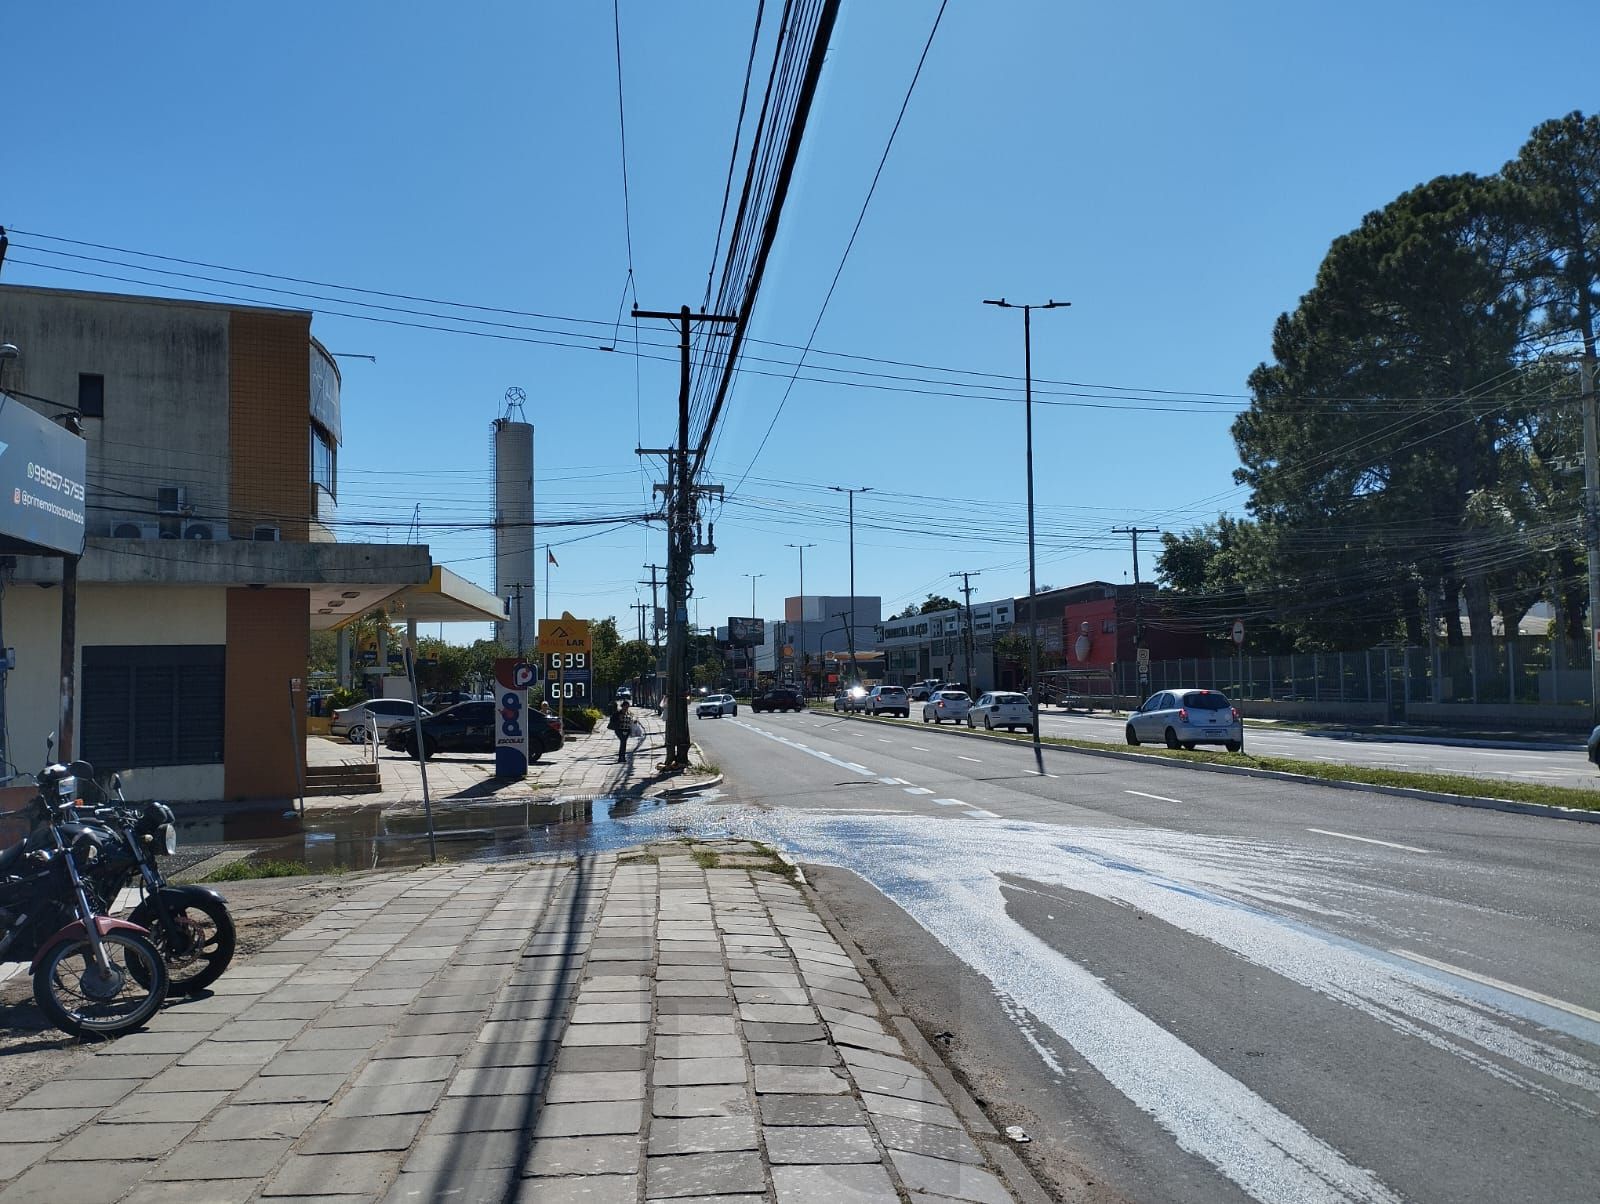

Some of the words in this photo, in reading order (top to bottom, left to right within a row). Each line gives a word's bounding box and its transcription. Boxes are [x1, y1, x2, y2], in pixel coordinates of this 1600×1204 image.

[34, 464, 85, 501] 99857-5753
[566, 639, 585, 647] LAR
[552, 653, 585, 668] 639
[551, 682, 585, 699] 607
